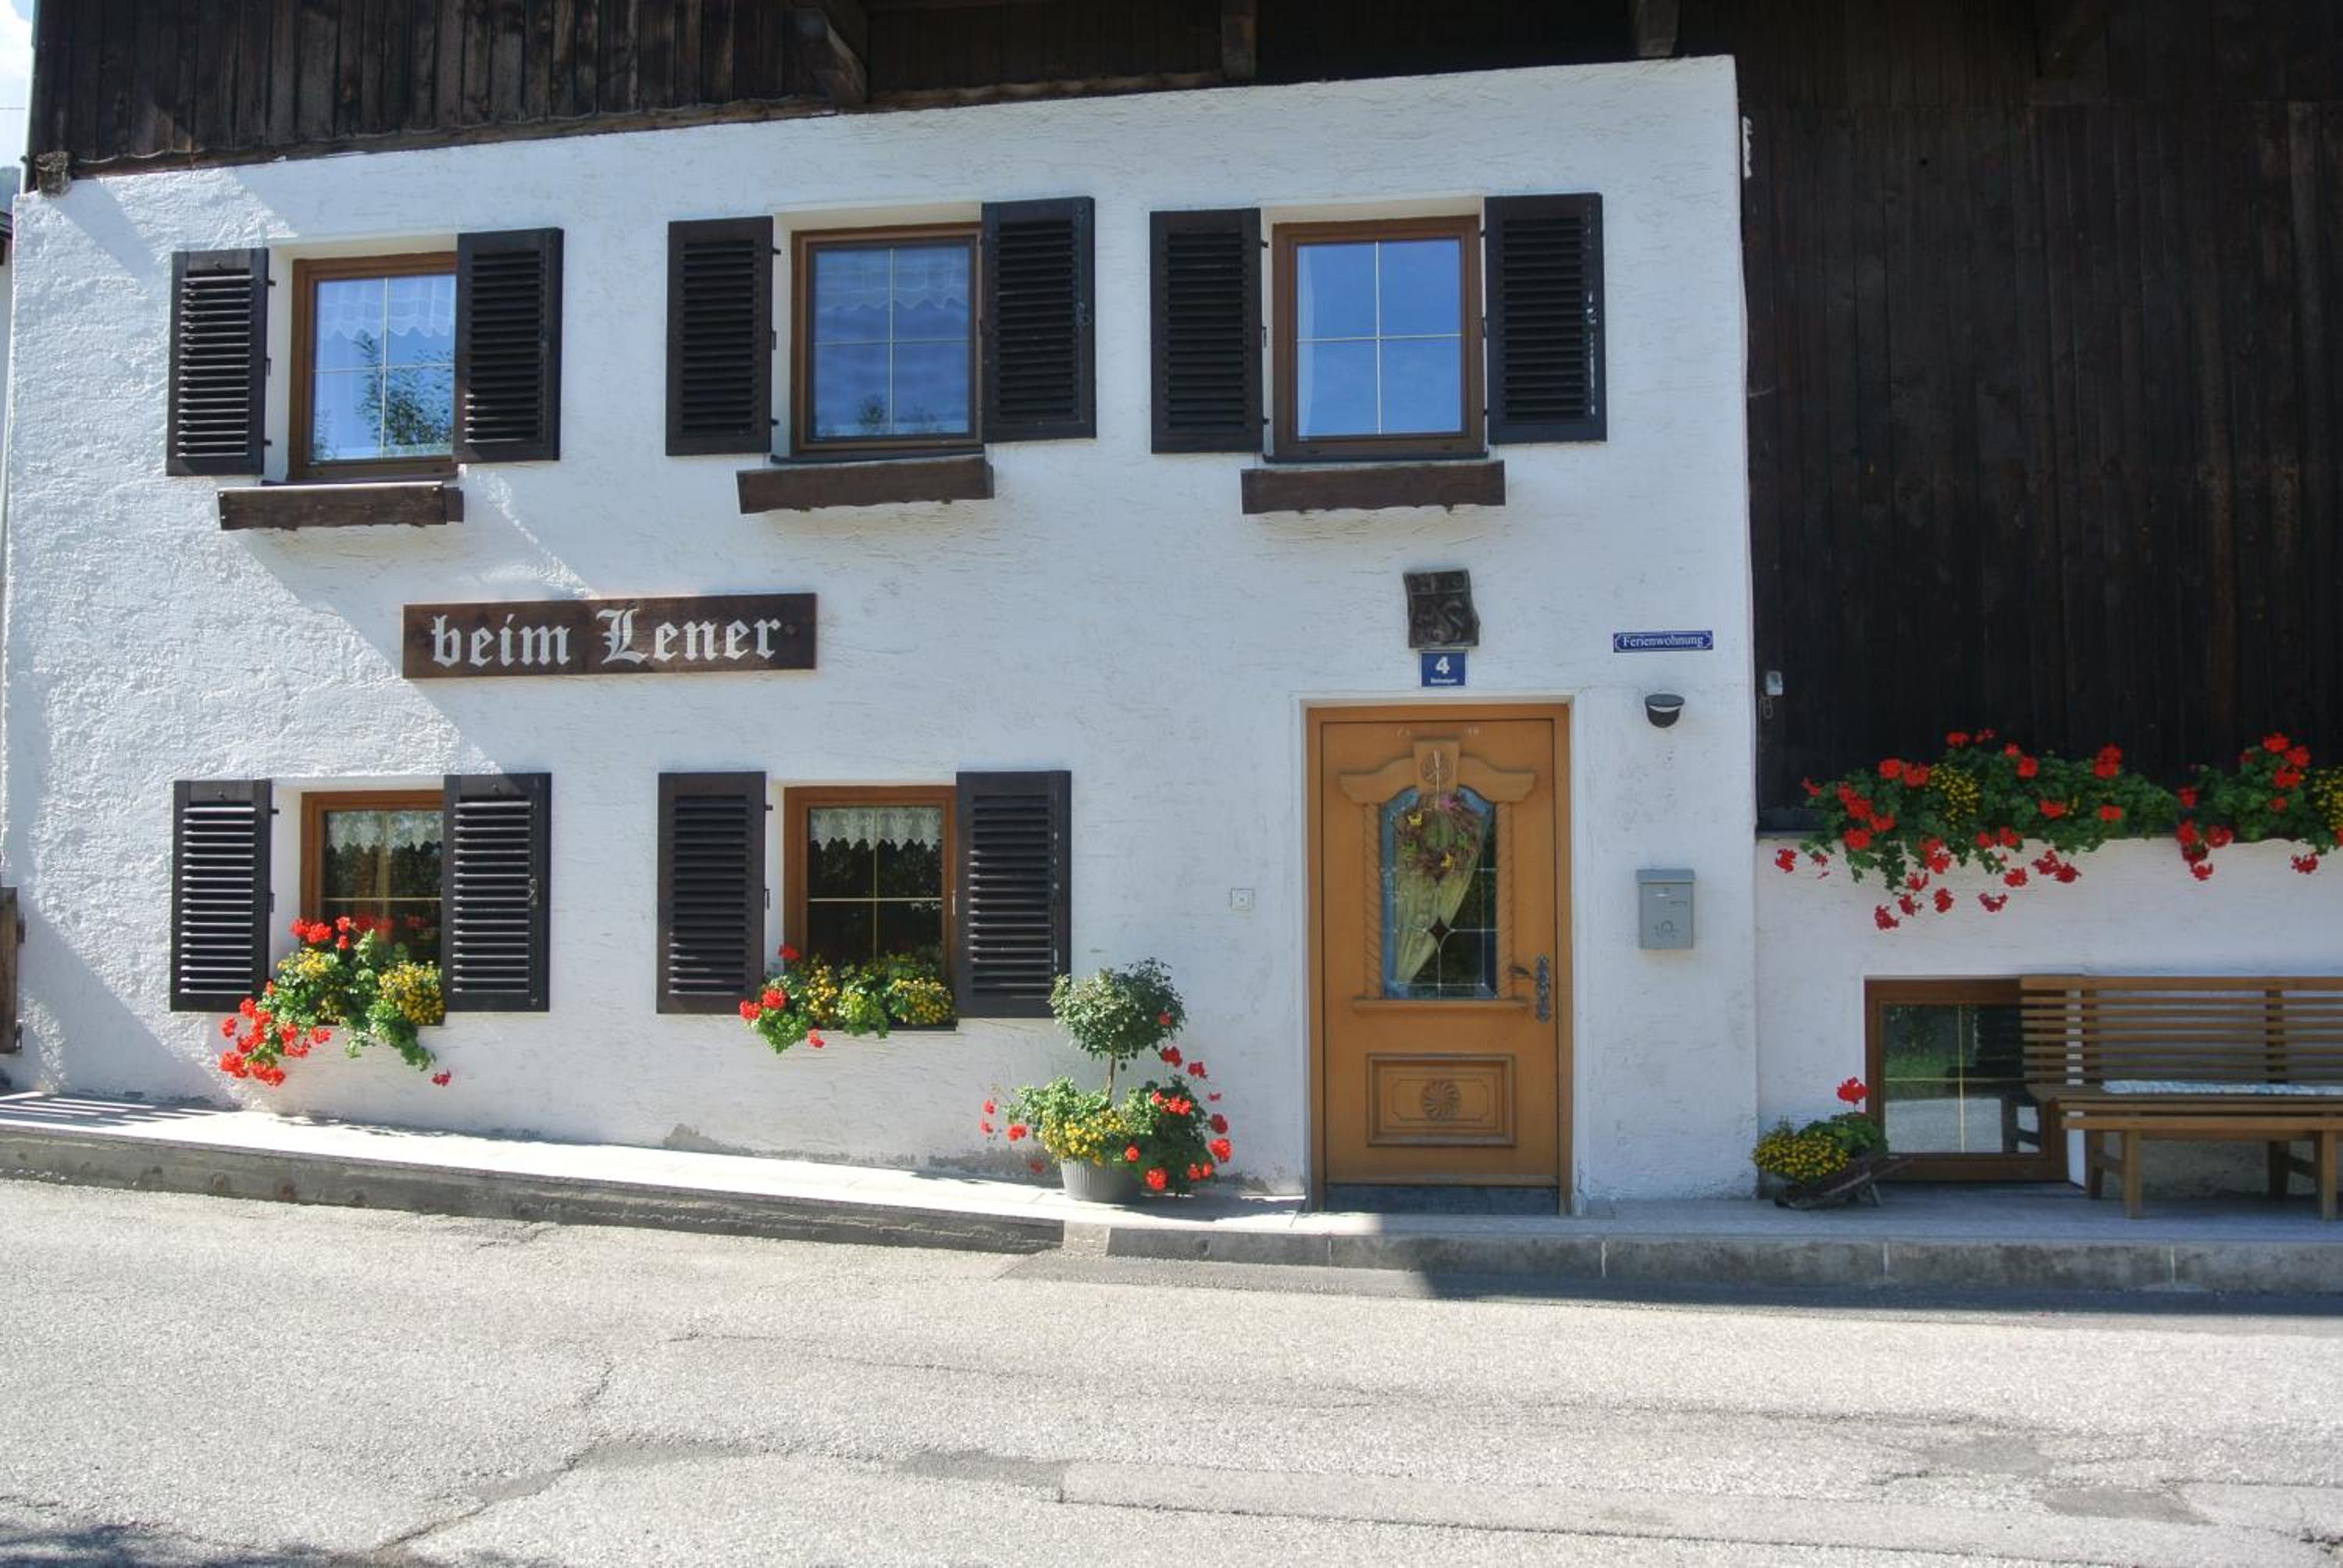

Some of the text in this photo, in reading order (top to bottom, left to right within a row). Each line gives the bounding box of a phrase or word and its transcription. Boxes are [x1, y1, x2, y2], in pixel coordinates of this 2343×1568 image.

[431, 608, 781, 668] beim Lener
[1435, 656, 1450, 675] 4
